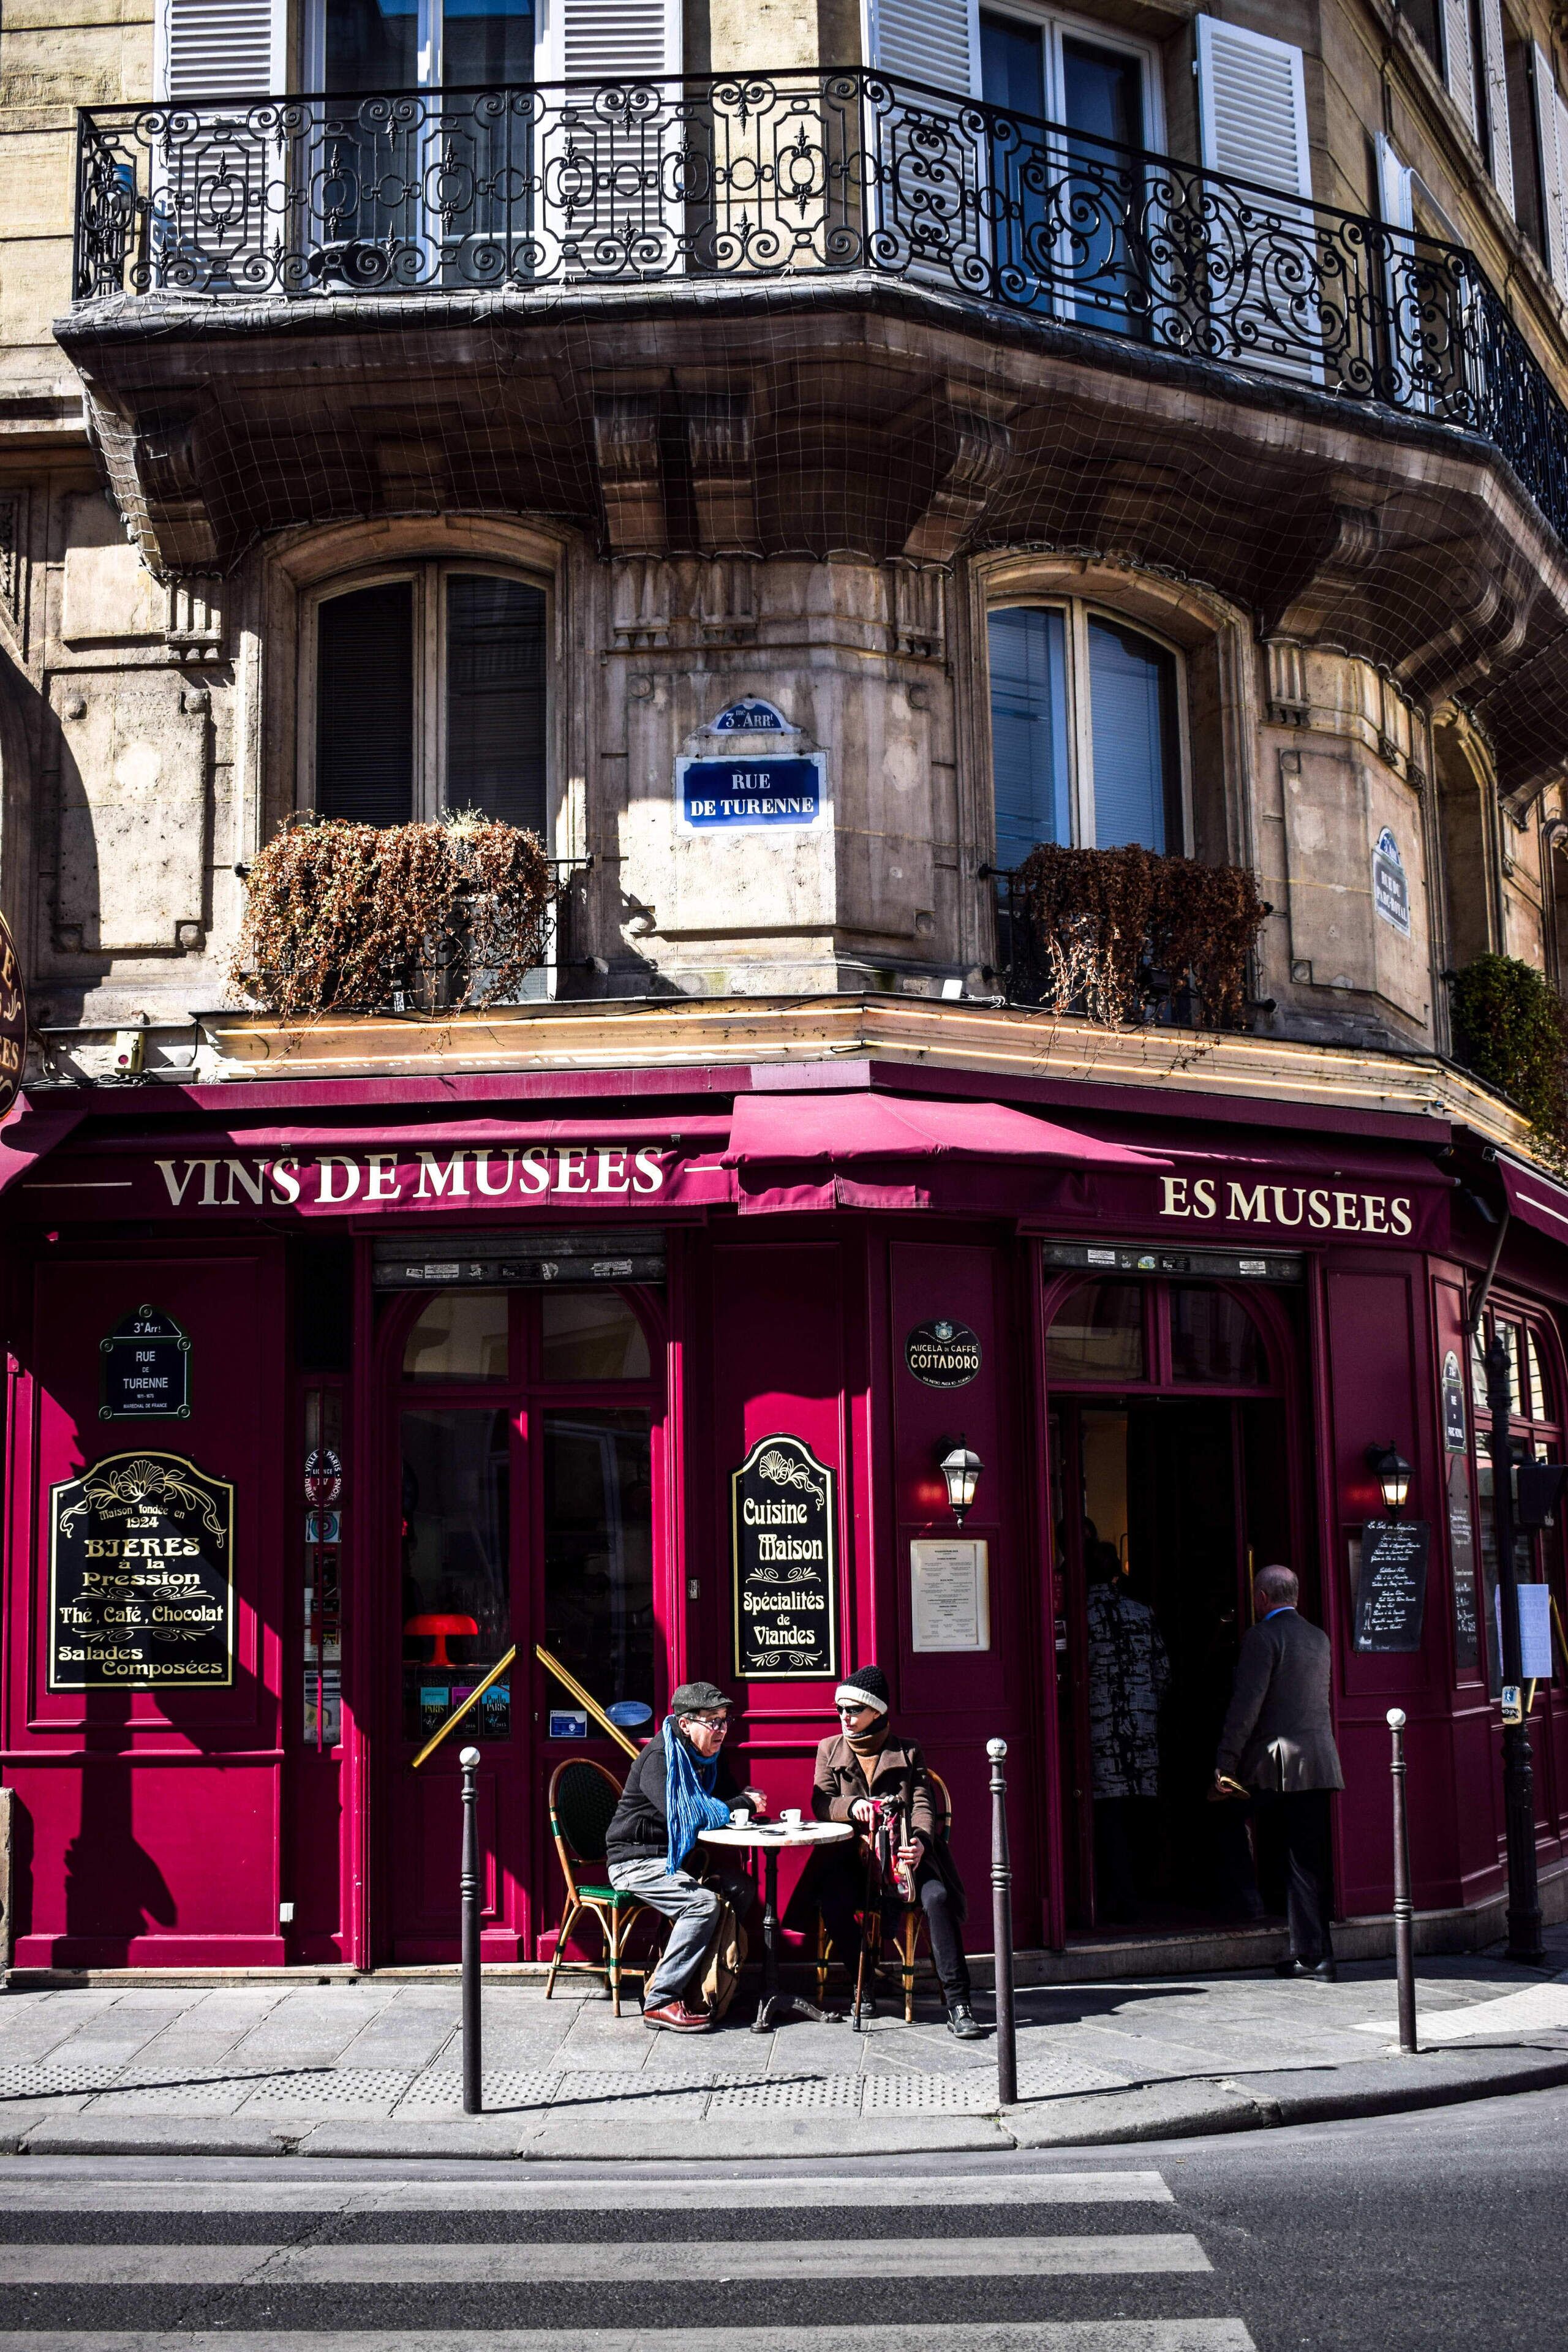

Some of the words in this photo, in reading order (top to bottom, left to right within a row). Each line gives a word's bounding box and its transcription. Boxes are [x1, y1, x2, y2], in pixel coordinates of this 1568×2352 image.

[732, 774, 771, 790] RUE
[691, 801, 716, 816] DE
[720, 797, 814, 815] TURENNE
[154, 1158, 300, 1205] VINS
[314, 1153, 401, 1202] DE
[413, 1147, 663, 1198] MUSEES
[1159, 1176, 1216, 1219] ES
[1226, 1182, 1412, 1236] MUSEES
[136, 1351, 156, 1362] RUE
[910, 1354, 979, 1369] COSTADORO
[123, 1378, 168, 1389] TURENNE
[305, 1452, 318, 1472] VILLE
[326, 1451, 341, 1471] PARIS
[99, 1506, 133, 1520] Maison
[138, 1504, 168, 1514] fondée
[174, 1510, 185, 1519] en
[743, 1498, 808, 1525] Cuisine
[125, 1517, 159, 1528] 1924
[84, 1538, 200, 1558] BIERES
[758, 1534, 823, 1561] Maison
[118, 1559, 131, 1569] à
[146, 1559, 165, 1569] la
[83, 1572, 201, 1586] Pression
[743, 1591, 824, 1615] Spécialités
[153, 1605, 224, 1621] Chocolat
[777, 1614, 790, 1625] de
[753, 1626, 815, 1645] Viandes
[59, 1646, 143, 1661] Salades
[102, 1660, 223, 1679] Composées
[424, 1705, 445, 1714] PARIS
[487, 1703, 507, 1711] PARIS
